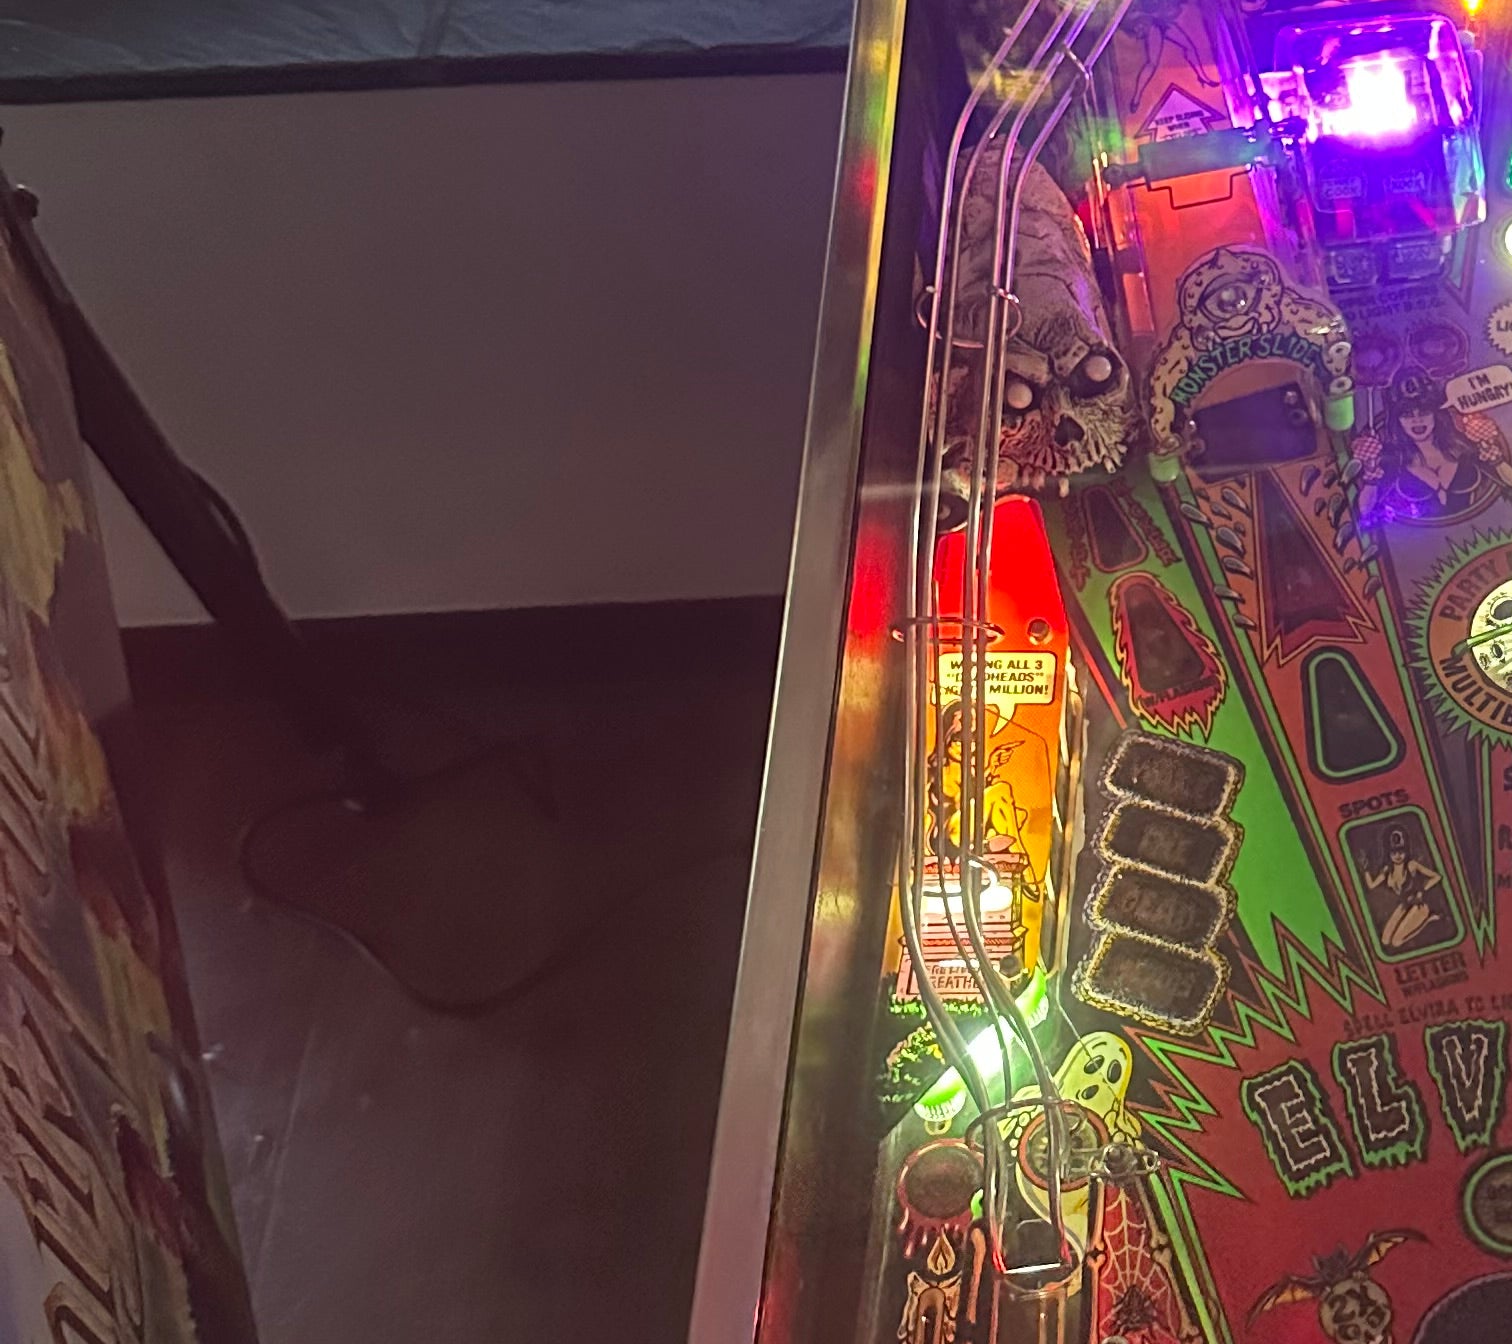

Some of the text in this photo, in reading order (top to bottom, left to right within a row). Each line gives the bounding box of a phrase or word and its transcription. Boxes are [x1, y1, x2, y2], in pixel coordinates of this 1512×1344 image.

[1438, 557, 1497, 622] PARTY
[1006, 659, 1031, 670] ALL
[1034, 659, 1043, 670] 3
[989, 684, 1049, 695] MILLION!
[1337, 788, 1409, 820] SPOTS
[1393, 950, 1467, 985] LETTER
[1398, 999, 1460, 1027] ELVIRA
